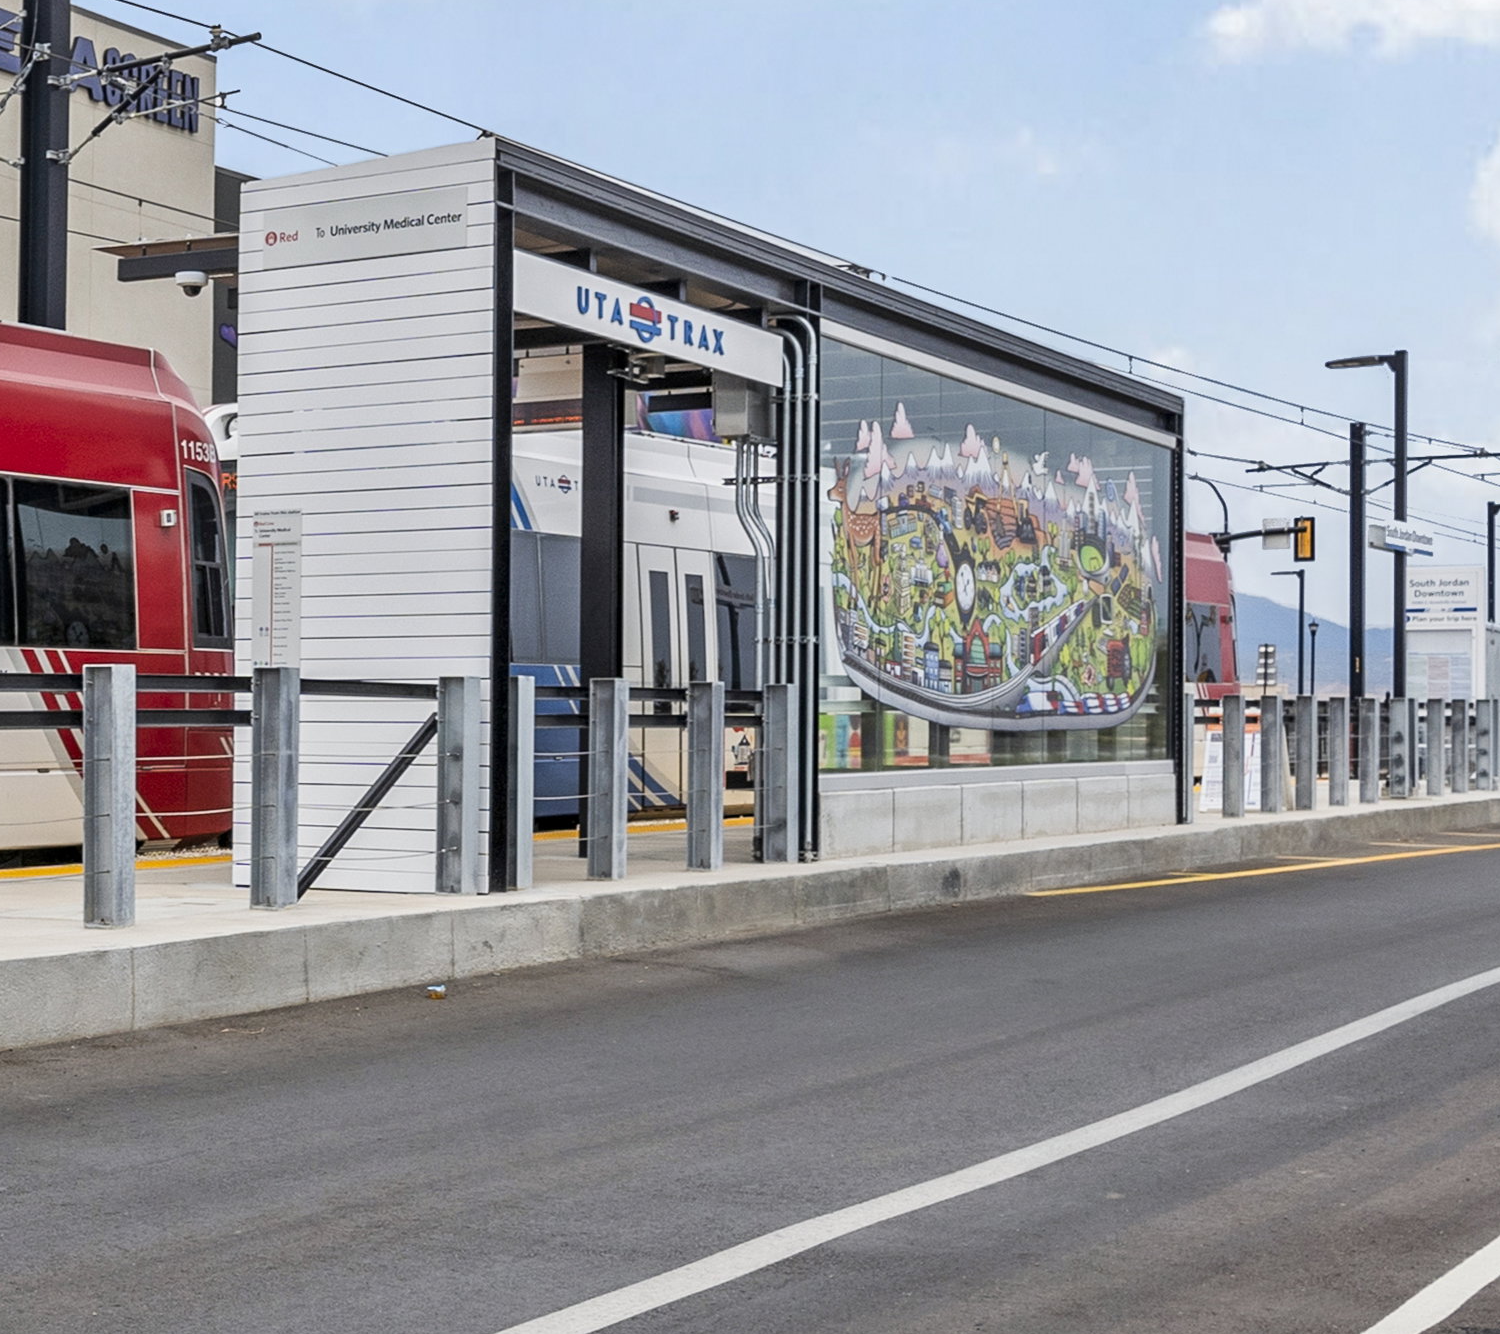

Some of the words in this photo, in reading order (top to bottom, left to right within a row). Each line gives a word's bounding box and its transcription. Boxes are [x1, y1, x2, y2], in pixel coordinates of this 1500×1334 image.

[279, 230, 299, 243] Red
[316, 227, 326, 239] To
[330, 220, 382, 238] University
[383, 214, 425, 231] Medical
[426, 211, 463, 226] Center
[576, 285, 624, 326] UTA
[667, 313, 725, 356] TRAX
[181, 439, 217, 464] 1153B
[535, 474, 556, 488] UTA
[1409, 578, 1436, 588] South
[1438, 577, 1470, 588] Jordan
[1414, 589, 1465, 598] Downtown
